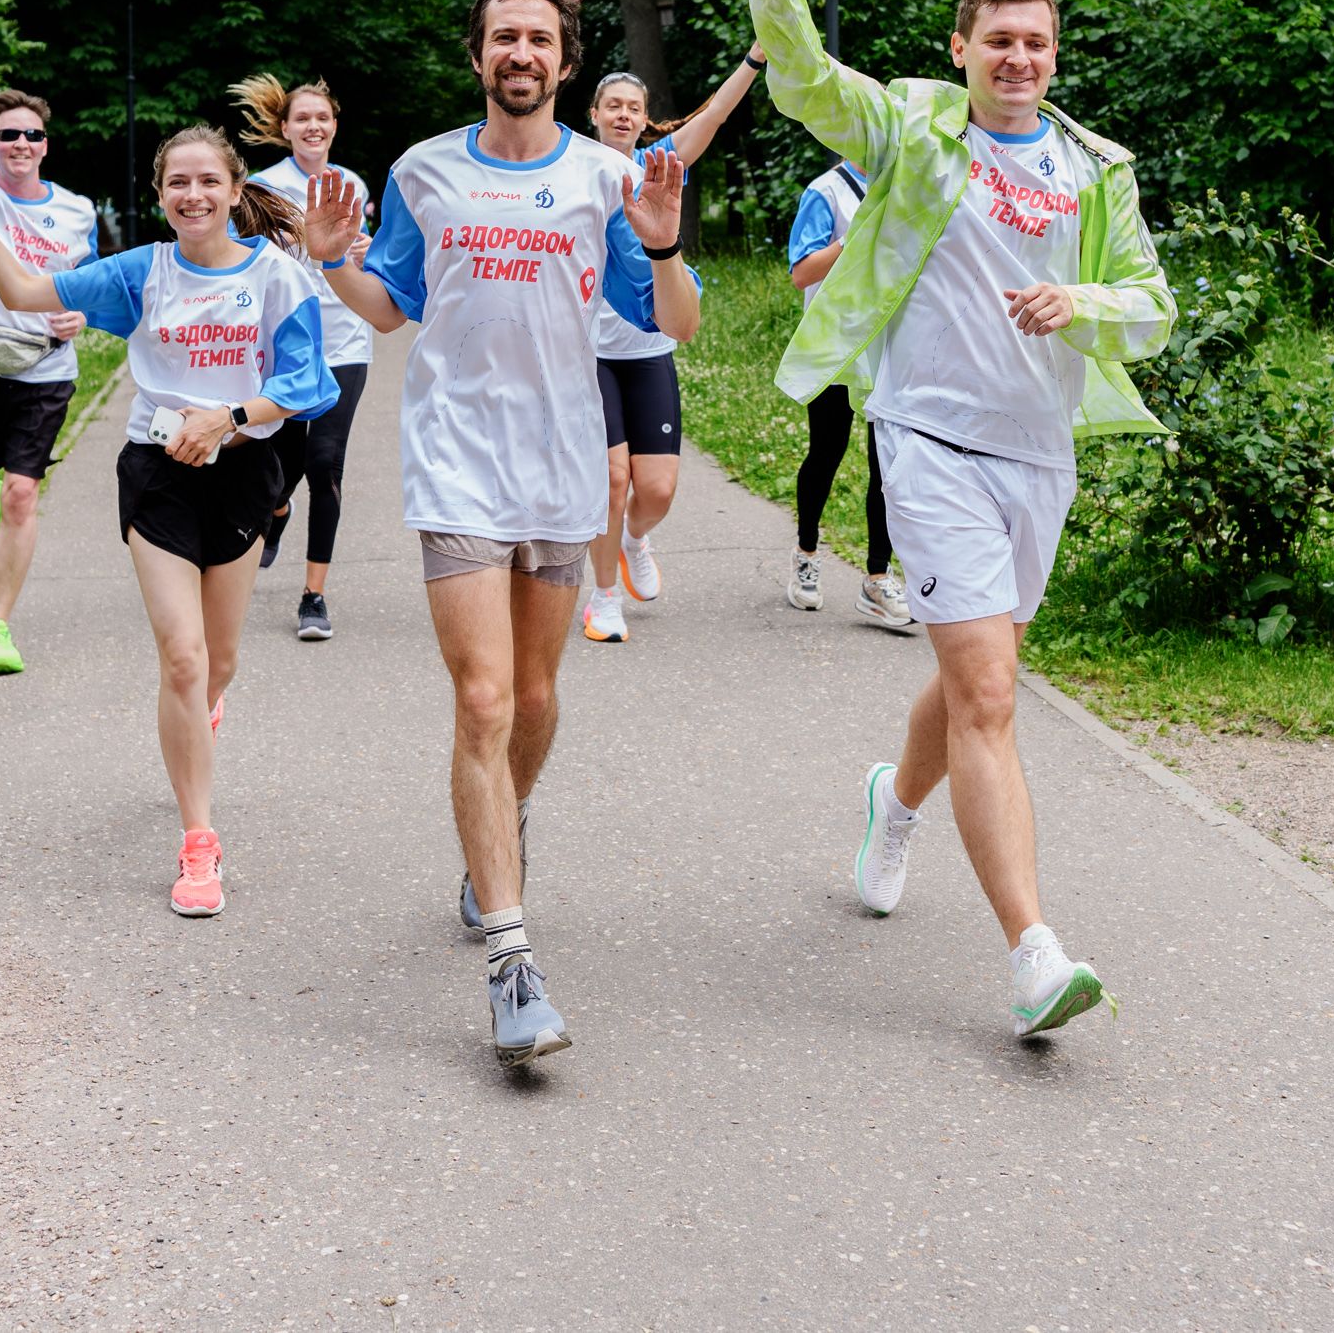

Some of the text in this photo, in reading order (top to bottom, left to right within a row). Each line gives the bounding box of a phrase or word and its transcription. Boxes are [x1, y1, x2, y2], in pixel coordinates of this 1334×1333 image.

[969, 160, 983, 180] В
[481, 191, 521, 200] ЛУЧИ
[988, 197, 1051, 238] ТЕМПЕ
[441, 225, 575, 257] В ЗДОРОВОМ
[472, 257, 541, 283] ТЕМПЕ
[193, 295, 225, 303] ЛУЧИ
[159, 327, 170, 343] В
[189, 348, 246, 368] ТЕМПЕ
